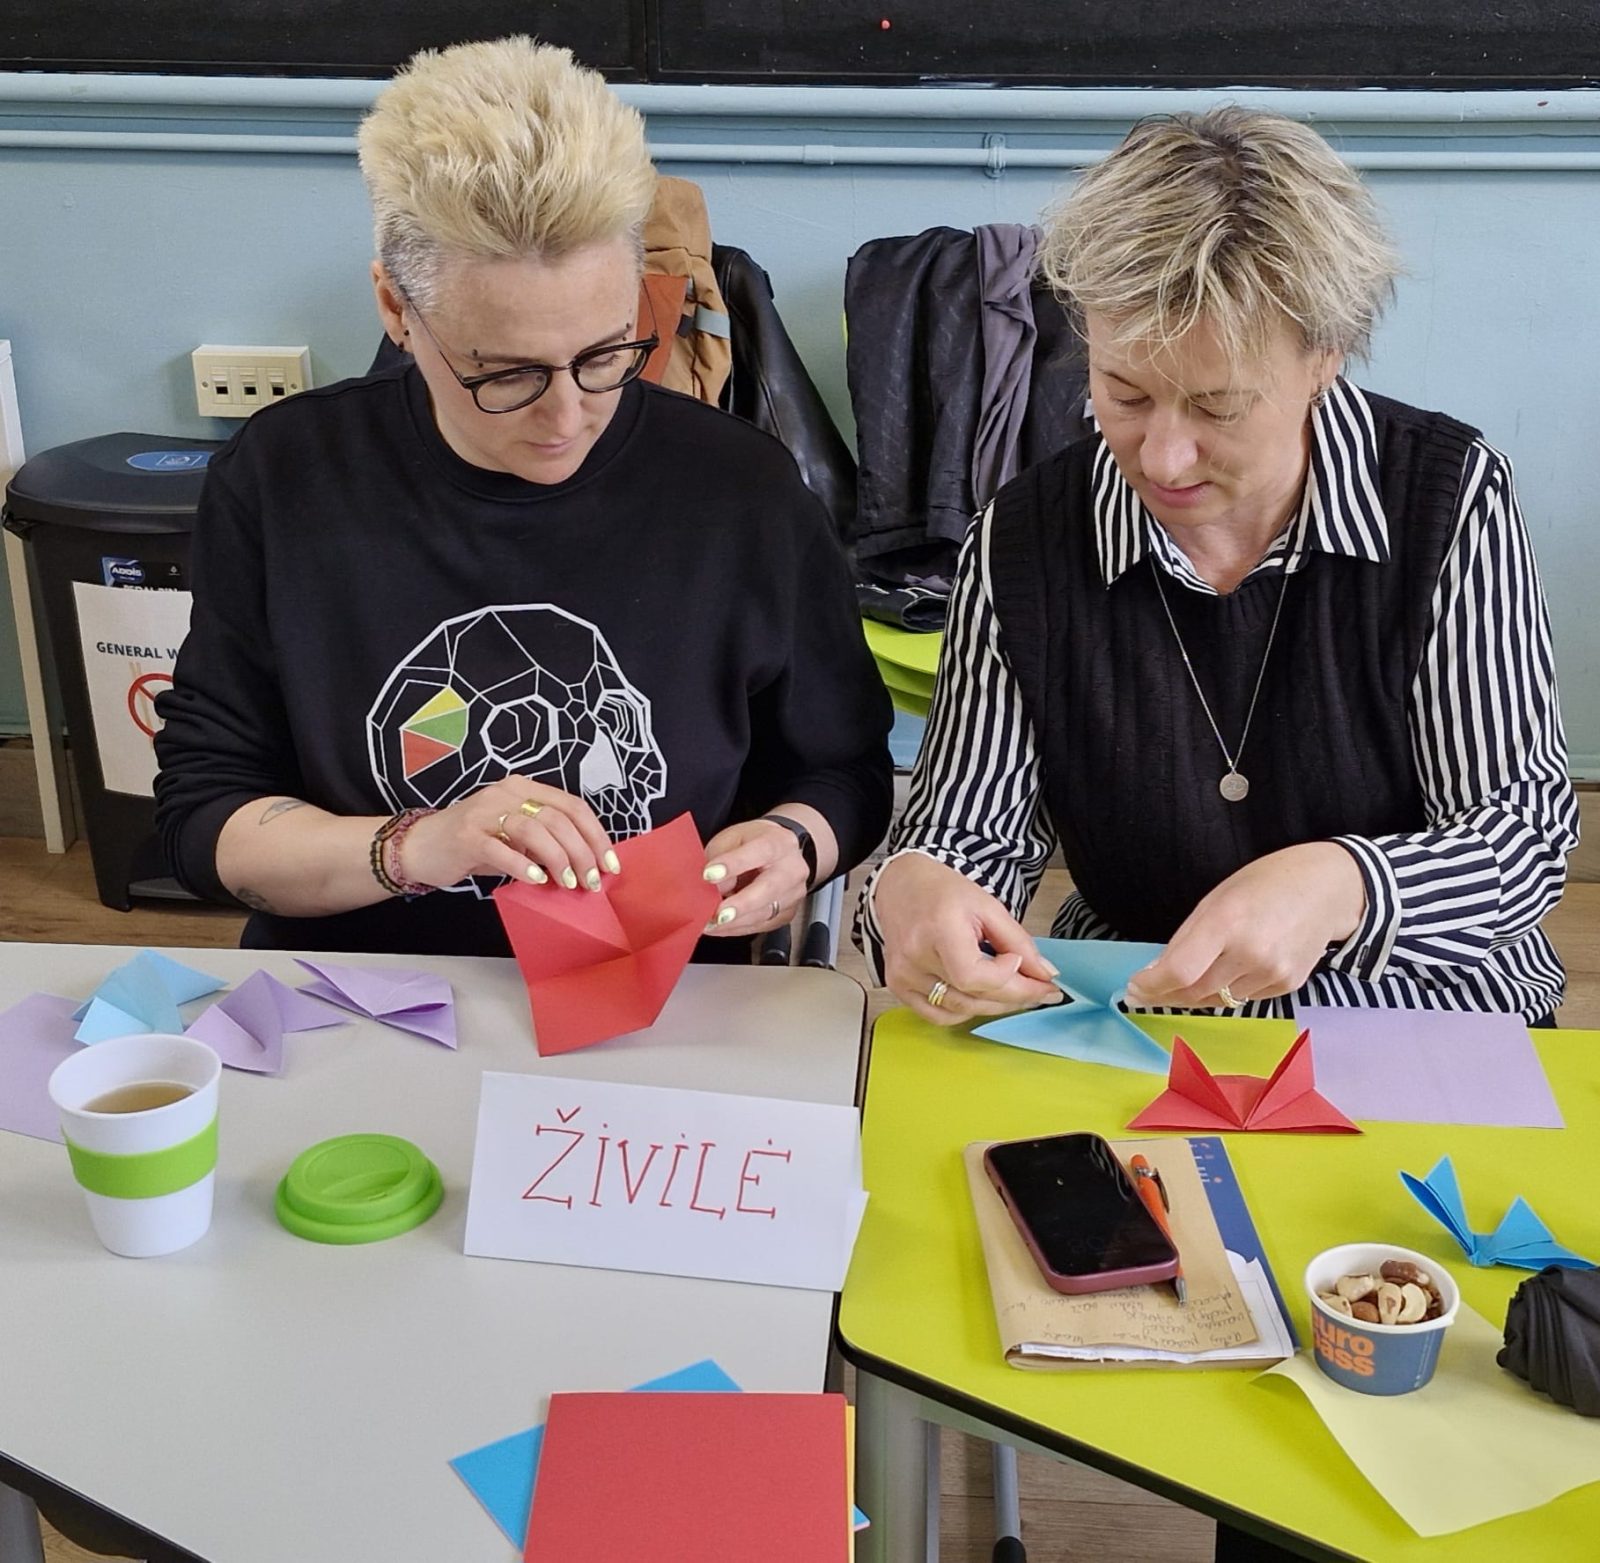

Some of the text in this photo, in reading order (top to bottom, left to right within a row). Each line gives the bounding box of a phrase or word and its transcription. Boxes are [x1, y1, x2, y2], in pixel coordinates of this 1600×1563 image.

[96, 641, 163, 659] GENERAL
[1312, 1306, 1375, 1357] uro
[1314, 1328, 1375, 1377] ass
